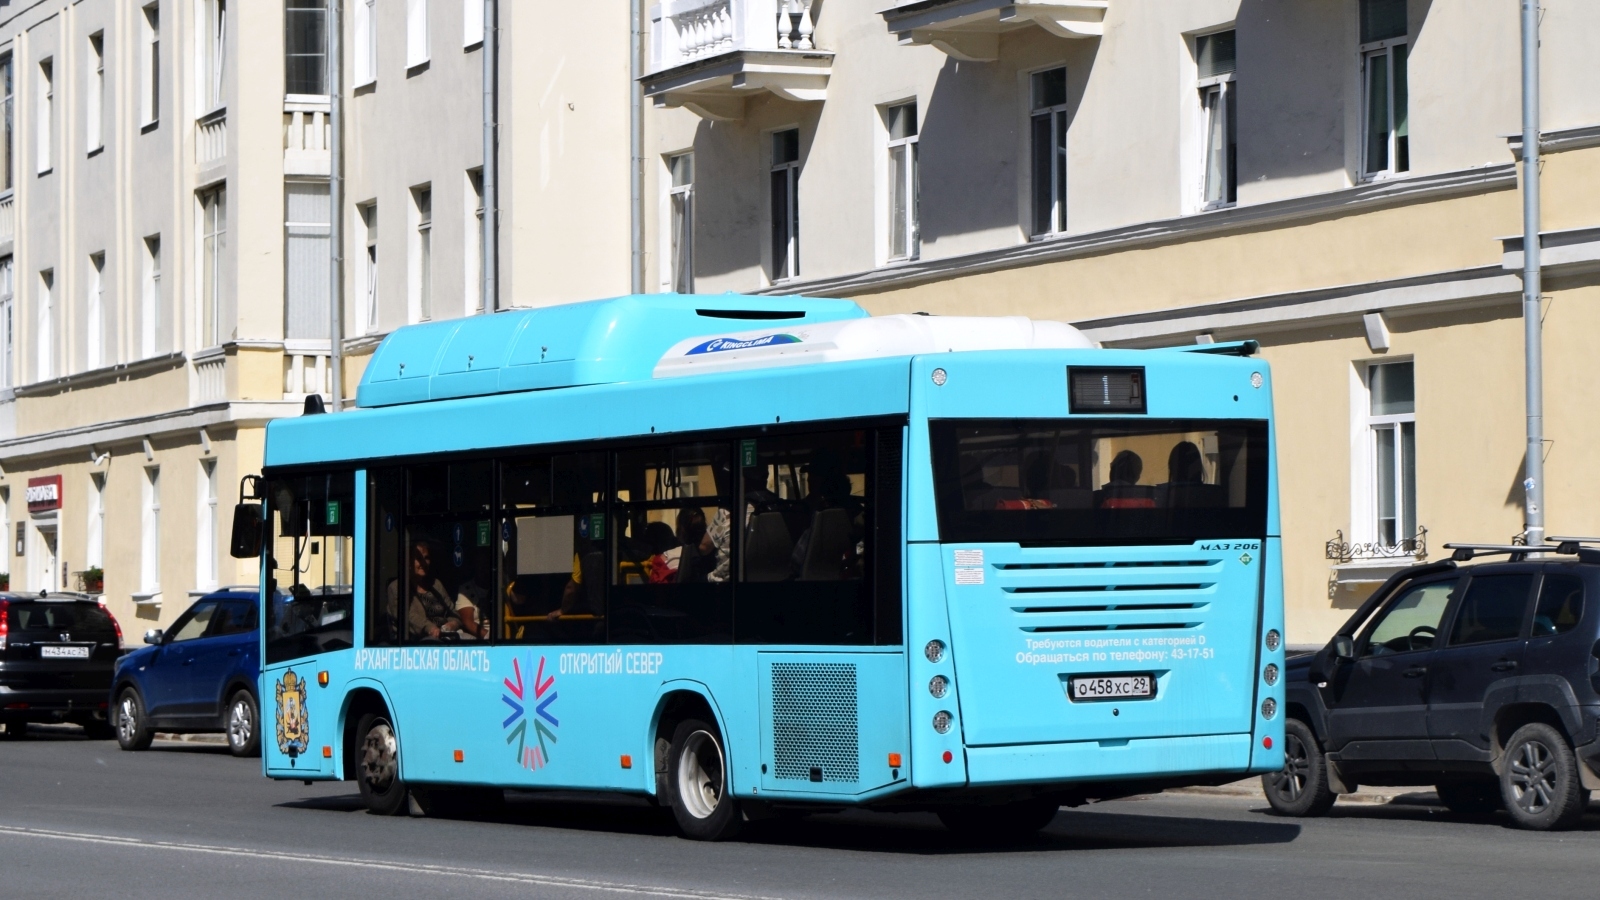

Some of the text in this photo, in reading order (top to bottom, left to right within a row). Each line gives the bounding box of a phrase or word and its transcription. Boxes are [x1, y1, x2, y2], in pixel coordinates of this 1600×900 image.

[720, 336, 774, 349] KINGCLIMA
[1102, 375, 1111, 405] 1
[1025, 634, 1206, 651] Требуются водители с категорией D
[355, 648, 490, 672] АРХАНГЕЛЬСКАЯ ОБЛАСТЬ
[560, 649, 662, 674] ОТКРЫТЫЙ СЕВЕР
[1016, 647, 1215, 665] Обращаться по телефону: 43-17-51
